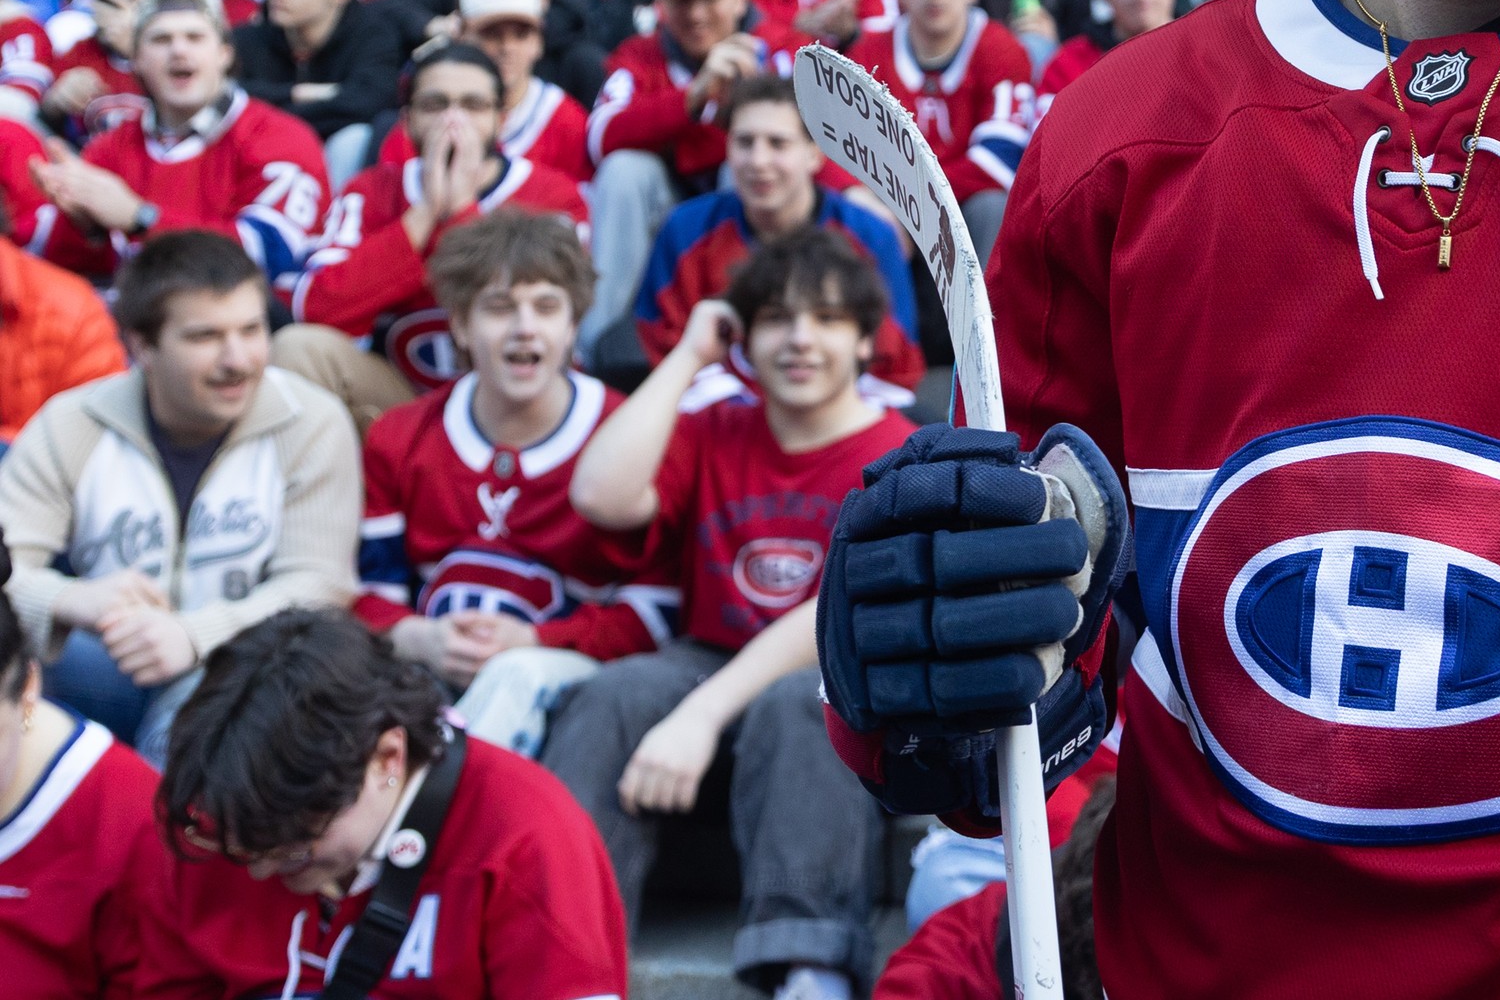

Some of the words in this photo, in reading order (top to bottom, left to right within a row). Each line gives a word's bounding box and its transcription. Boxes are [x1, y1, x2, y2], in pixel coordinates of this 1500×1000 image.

[803, 52, 870, 121] GOAL
[1420, 61, 1458, 91] LNH
[843, 131, 884, 187] TAP
[872, 98, 915, 168] ONE
[882, 167, 922, 232] ONE
[390, 893, 442, 980] A
